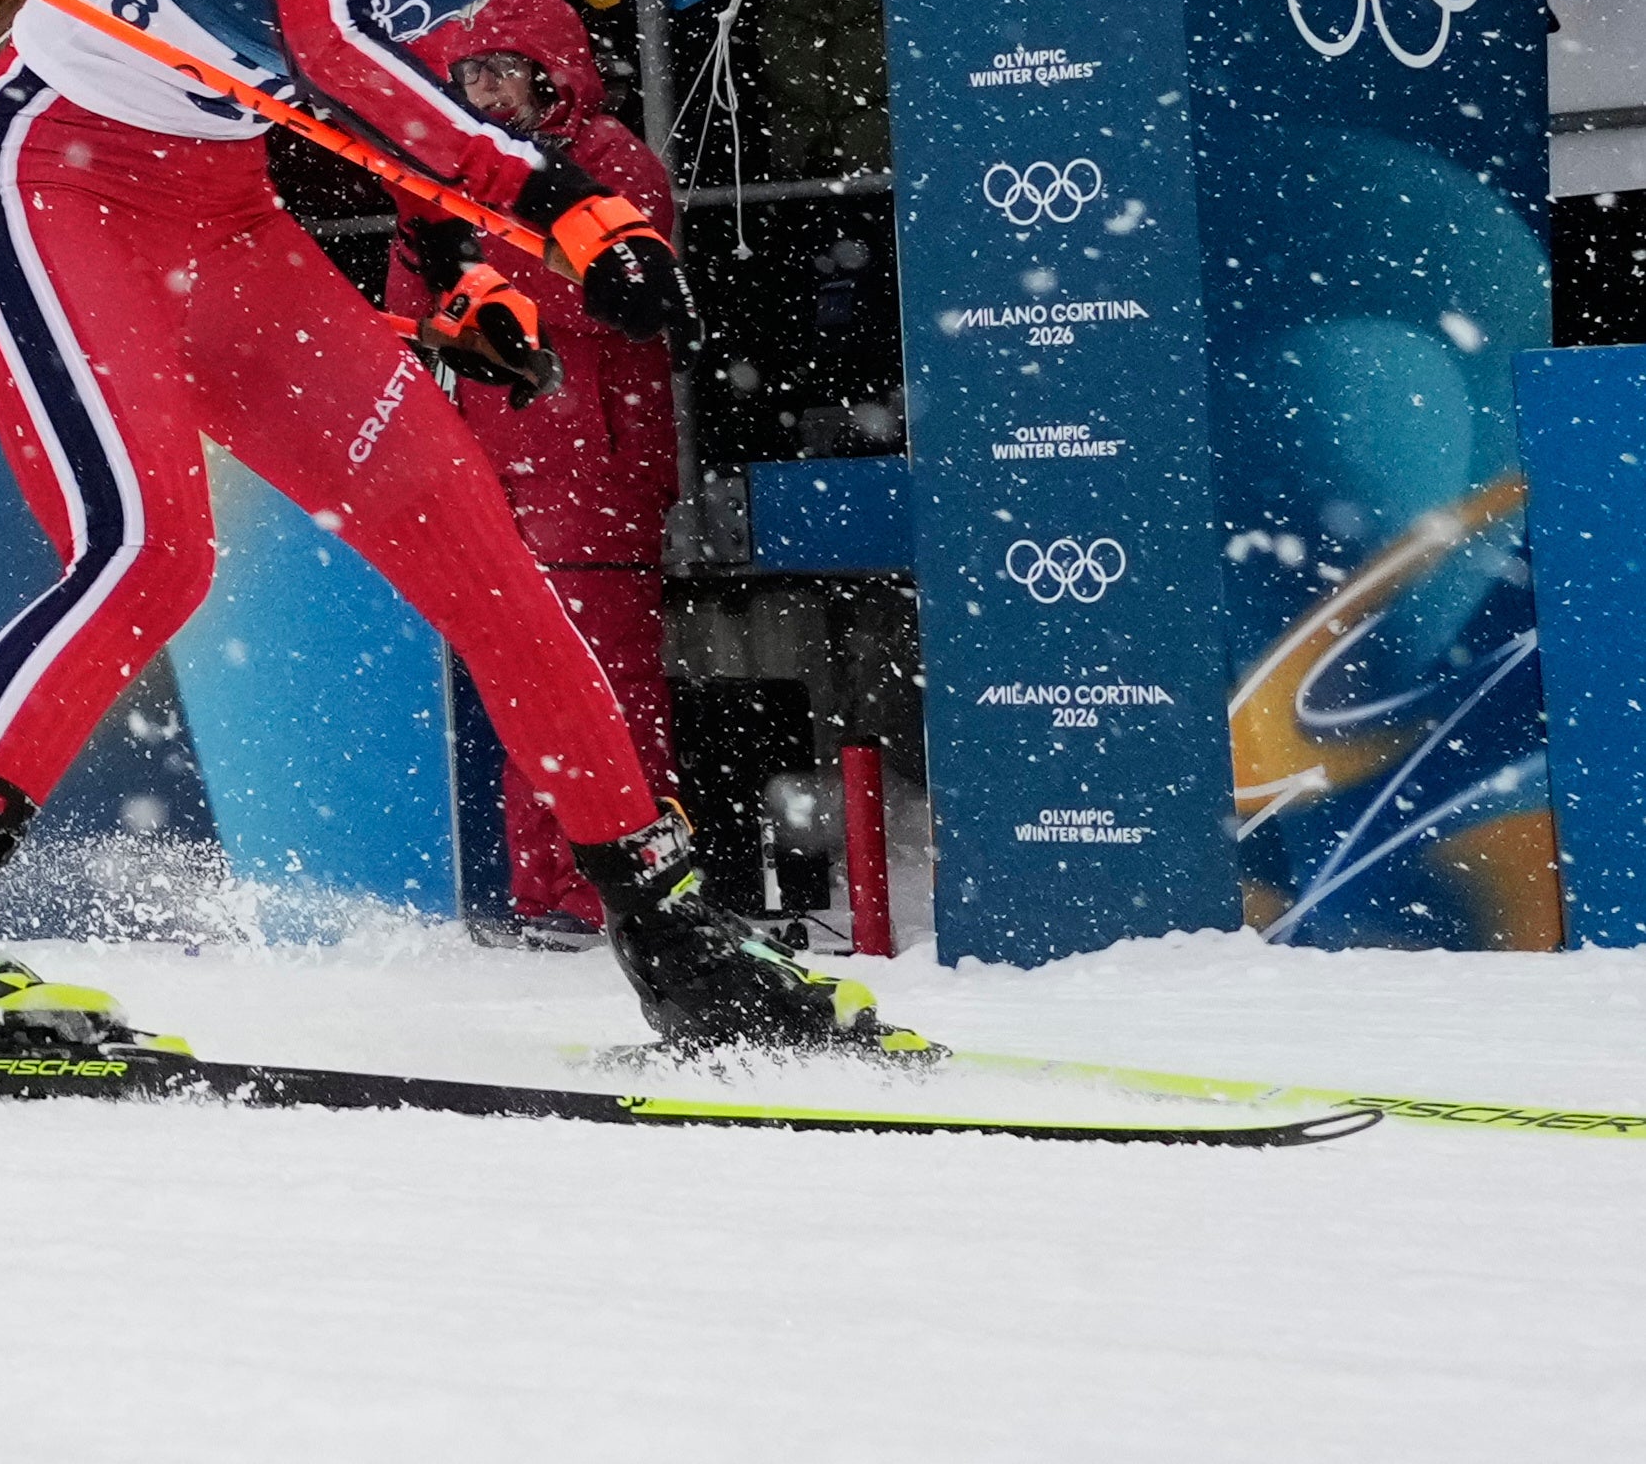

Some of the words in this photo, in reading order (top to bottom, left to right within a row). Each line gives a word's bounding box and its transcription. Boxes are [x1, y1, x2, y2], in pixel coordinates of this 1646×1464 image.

[993, 49, 1067, 69] OLYMPIC
[969, 68, 1032, 87] WINTER
[955, 305, 1047, 328] MILANO
[1050, 300, 1150, 322] CORTINA
[1028, 326, 1075, 346] 2026
[348, 361, 416, 464] CRAFT
[1015, 425, 1091, 442] OLYMPIC
[992, 442, 1055, 460] WINTER
[976, 685, 1071, 706] MILANO
[1074, 685, 1175, 706] CORTINA
[1052, 708, 1099, 727] 2026
[1039, 809, 1115, 826] OLYMPIC
[1014, 826, 1079, 842] WINTER
